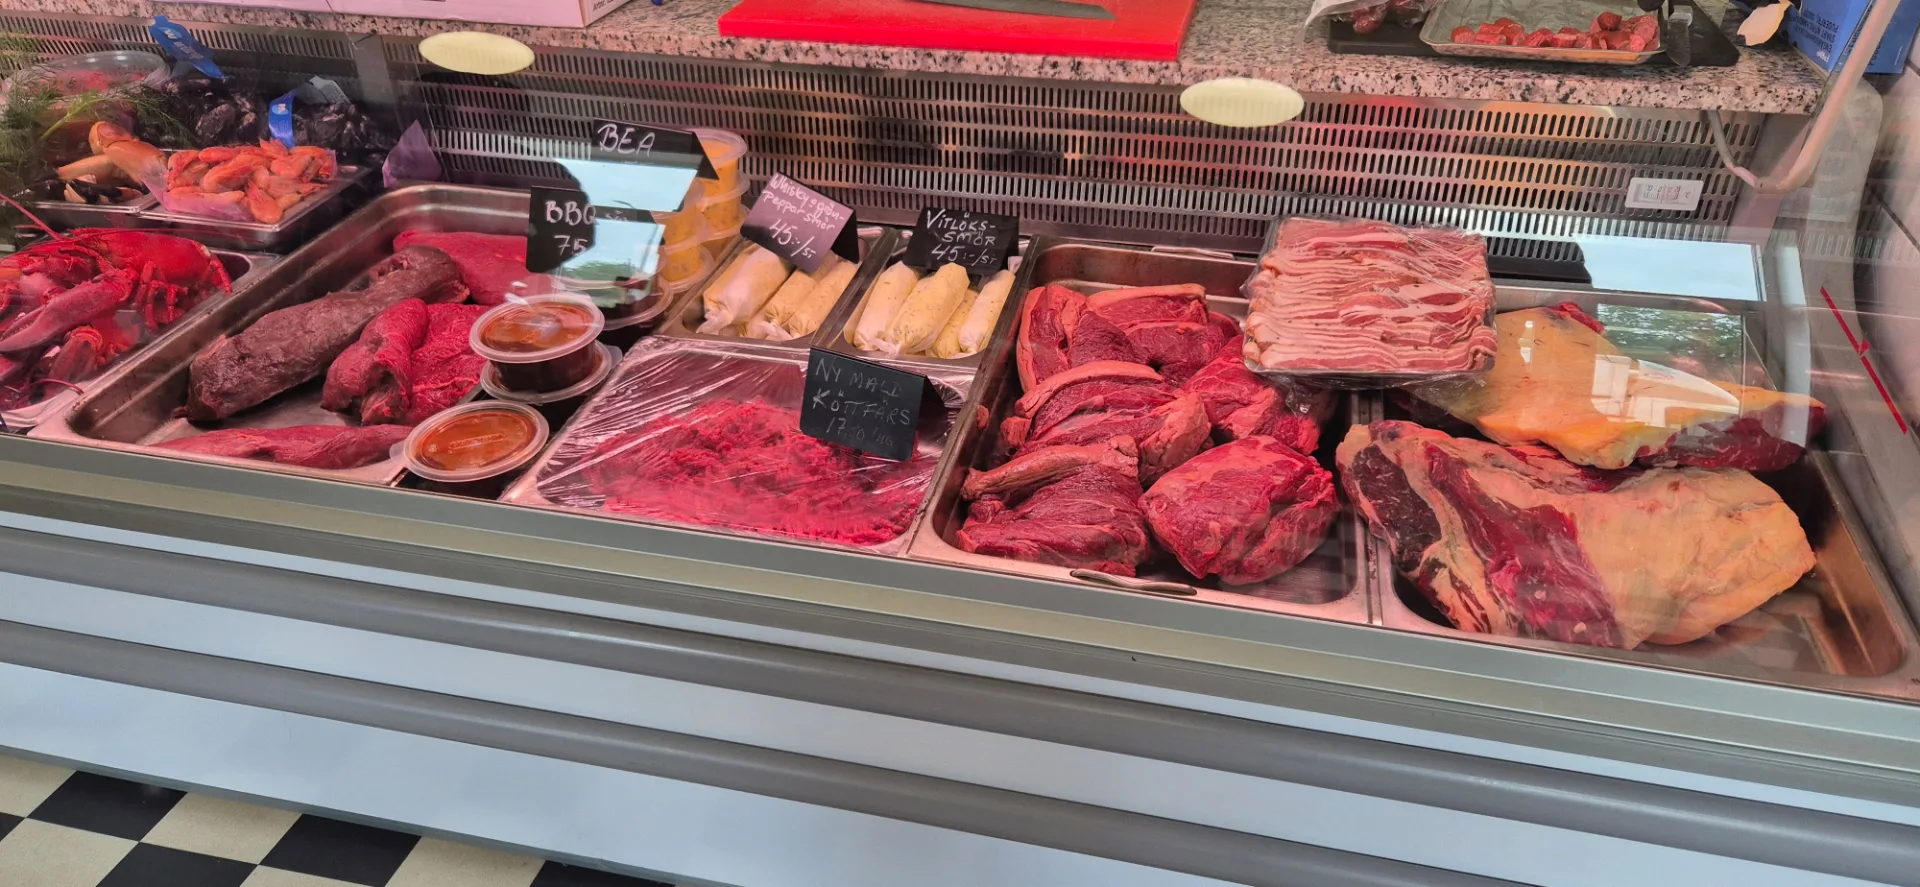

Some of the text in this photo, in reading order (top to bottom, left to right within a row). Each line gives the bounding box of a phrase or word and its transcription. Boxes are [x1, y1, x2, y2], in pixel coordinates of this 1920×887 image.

[597, 123, 656, 157] BEA
[770, 173, 811, 208] Whisky
[545, 200, 598, 226] BBQ
[941, 231, 996, 247] SMÖR
[815, 356, 842, 383] NY
[812, 388, 911, 426] KÖTTFÄRS
